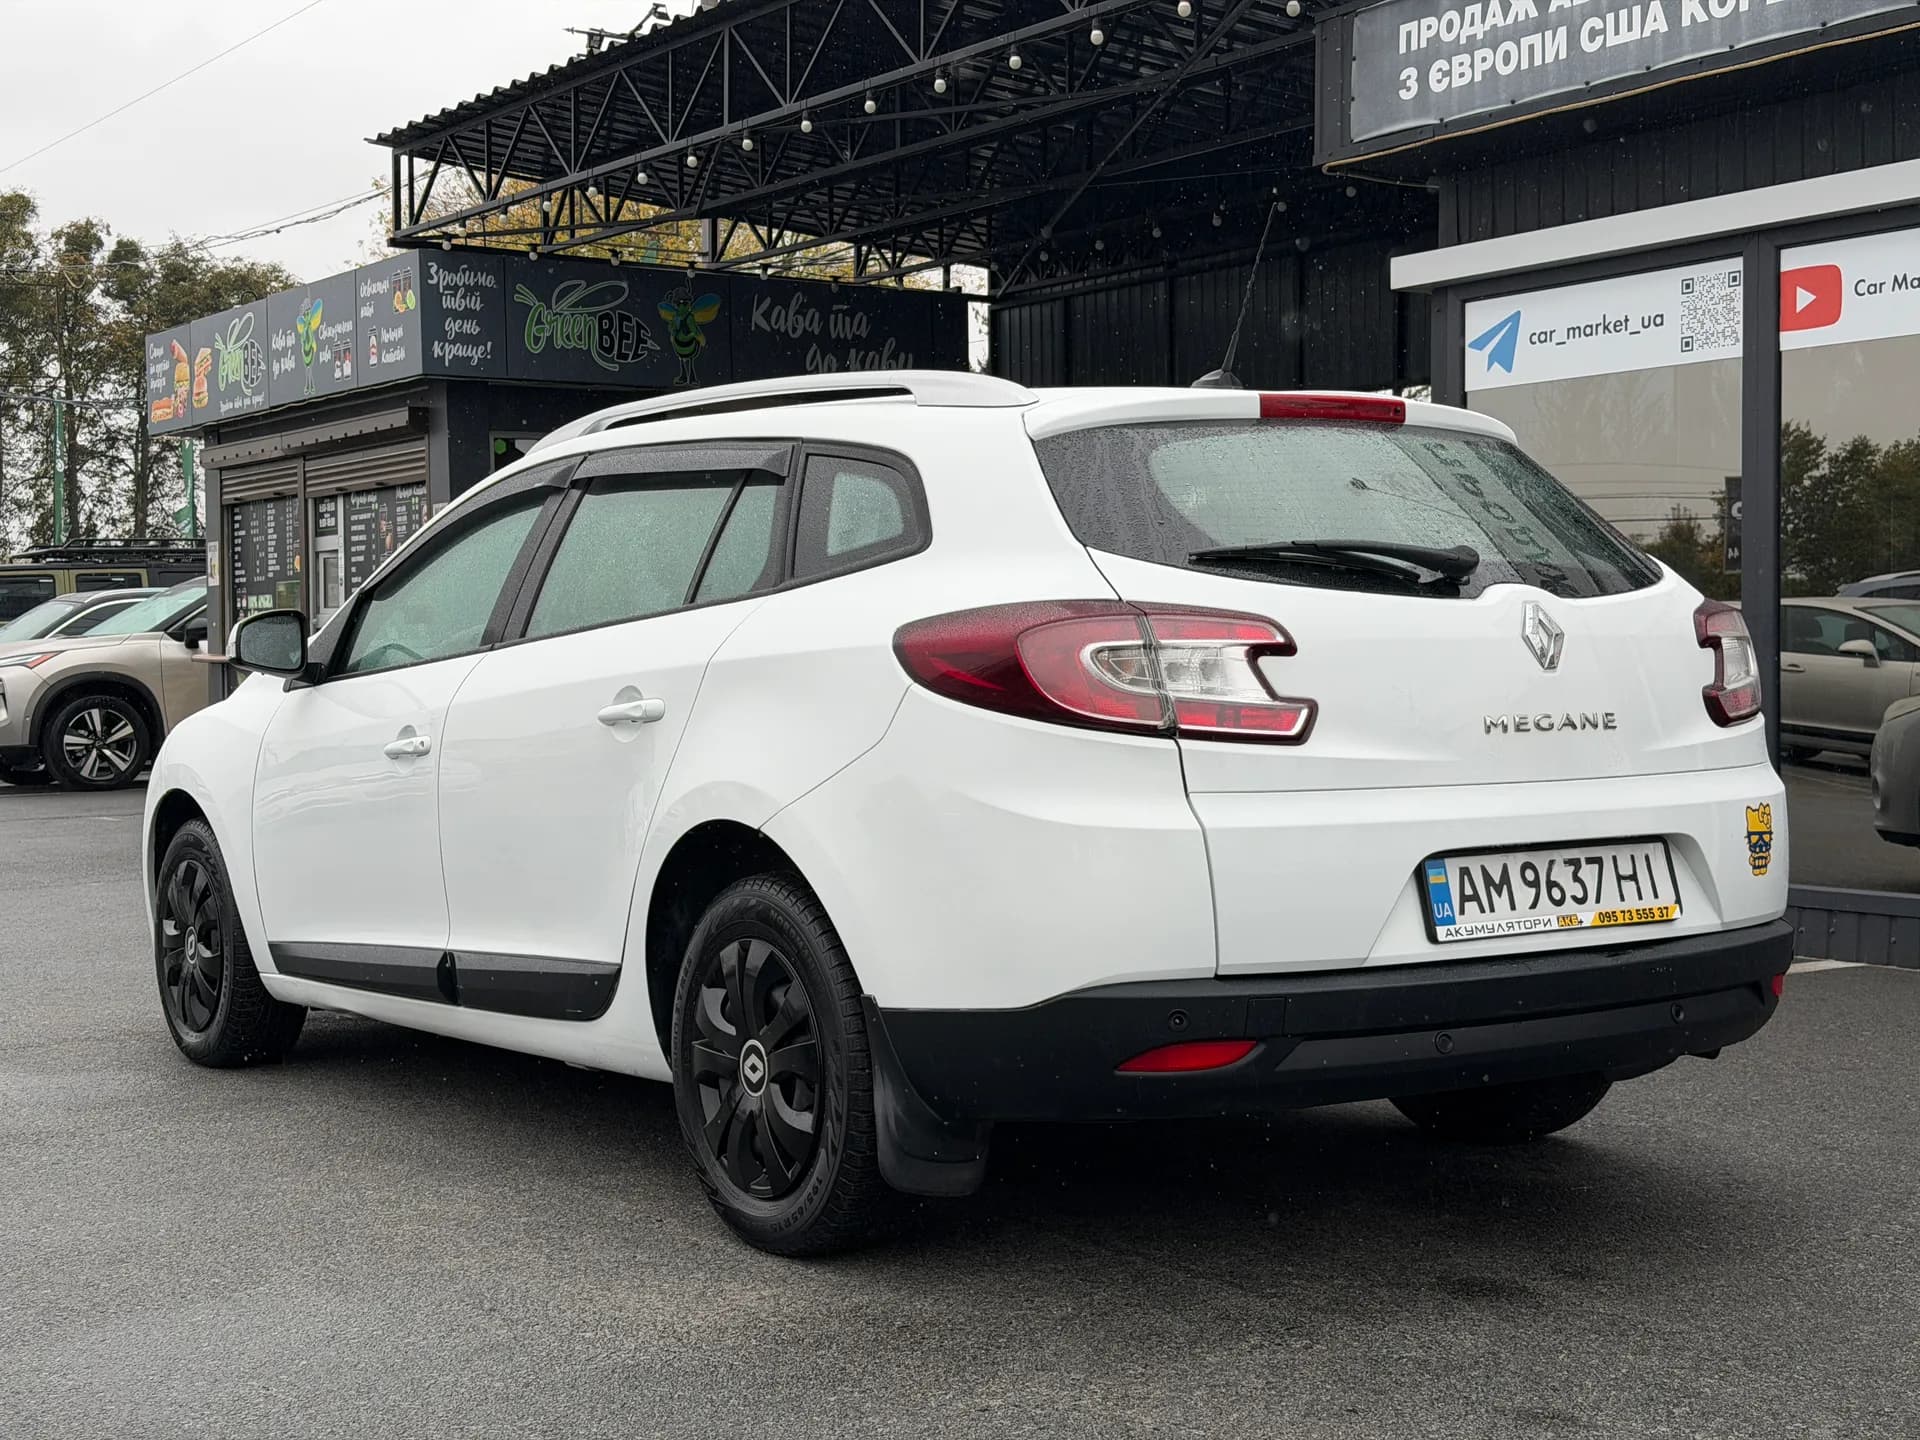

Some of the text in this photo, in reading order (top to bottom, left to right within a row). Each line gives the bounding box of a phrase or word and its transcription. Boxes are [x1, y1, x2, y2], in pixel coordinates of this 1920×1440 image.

[1399, 0, 1539, 54] ПРОДАЖ
[1428, 25, 1567, 93] ЄВРОПИ
[1580, 3, 1668, 53] США
[427, 261, 496, 293] Зробимо
[1854, 272, 1920, 297] Car Ma
[442, 287, 485, 312] твій
[444, 317, 482, 340] день
[752, 291, 871, 340] Кава та
[1528, 312, 1665, 347] car_market_ua
[432, 340, 492, 367] краще!
[1483, 711, 1618, 735] MEGANE
[1434, 903, 1453, 919] UA
[1445, 918, 1552, 938] АКУМУЛЯТОРИ
[1598, 910, 1618, 924] 095
[1620, 909, 1634, 922] 73
[1635, 908, 1656, 920] 555
[1657, 906, 1670, 918] 37
